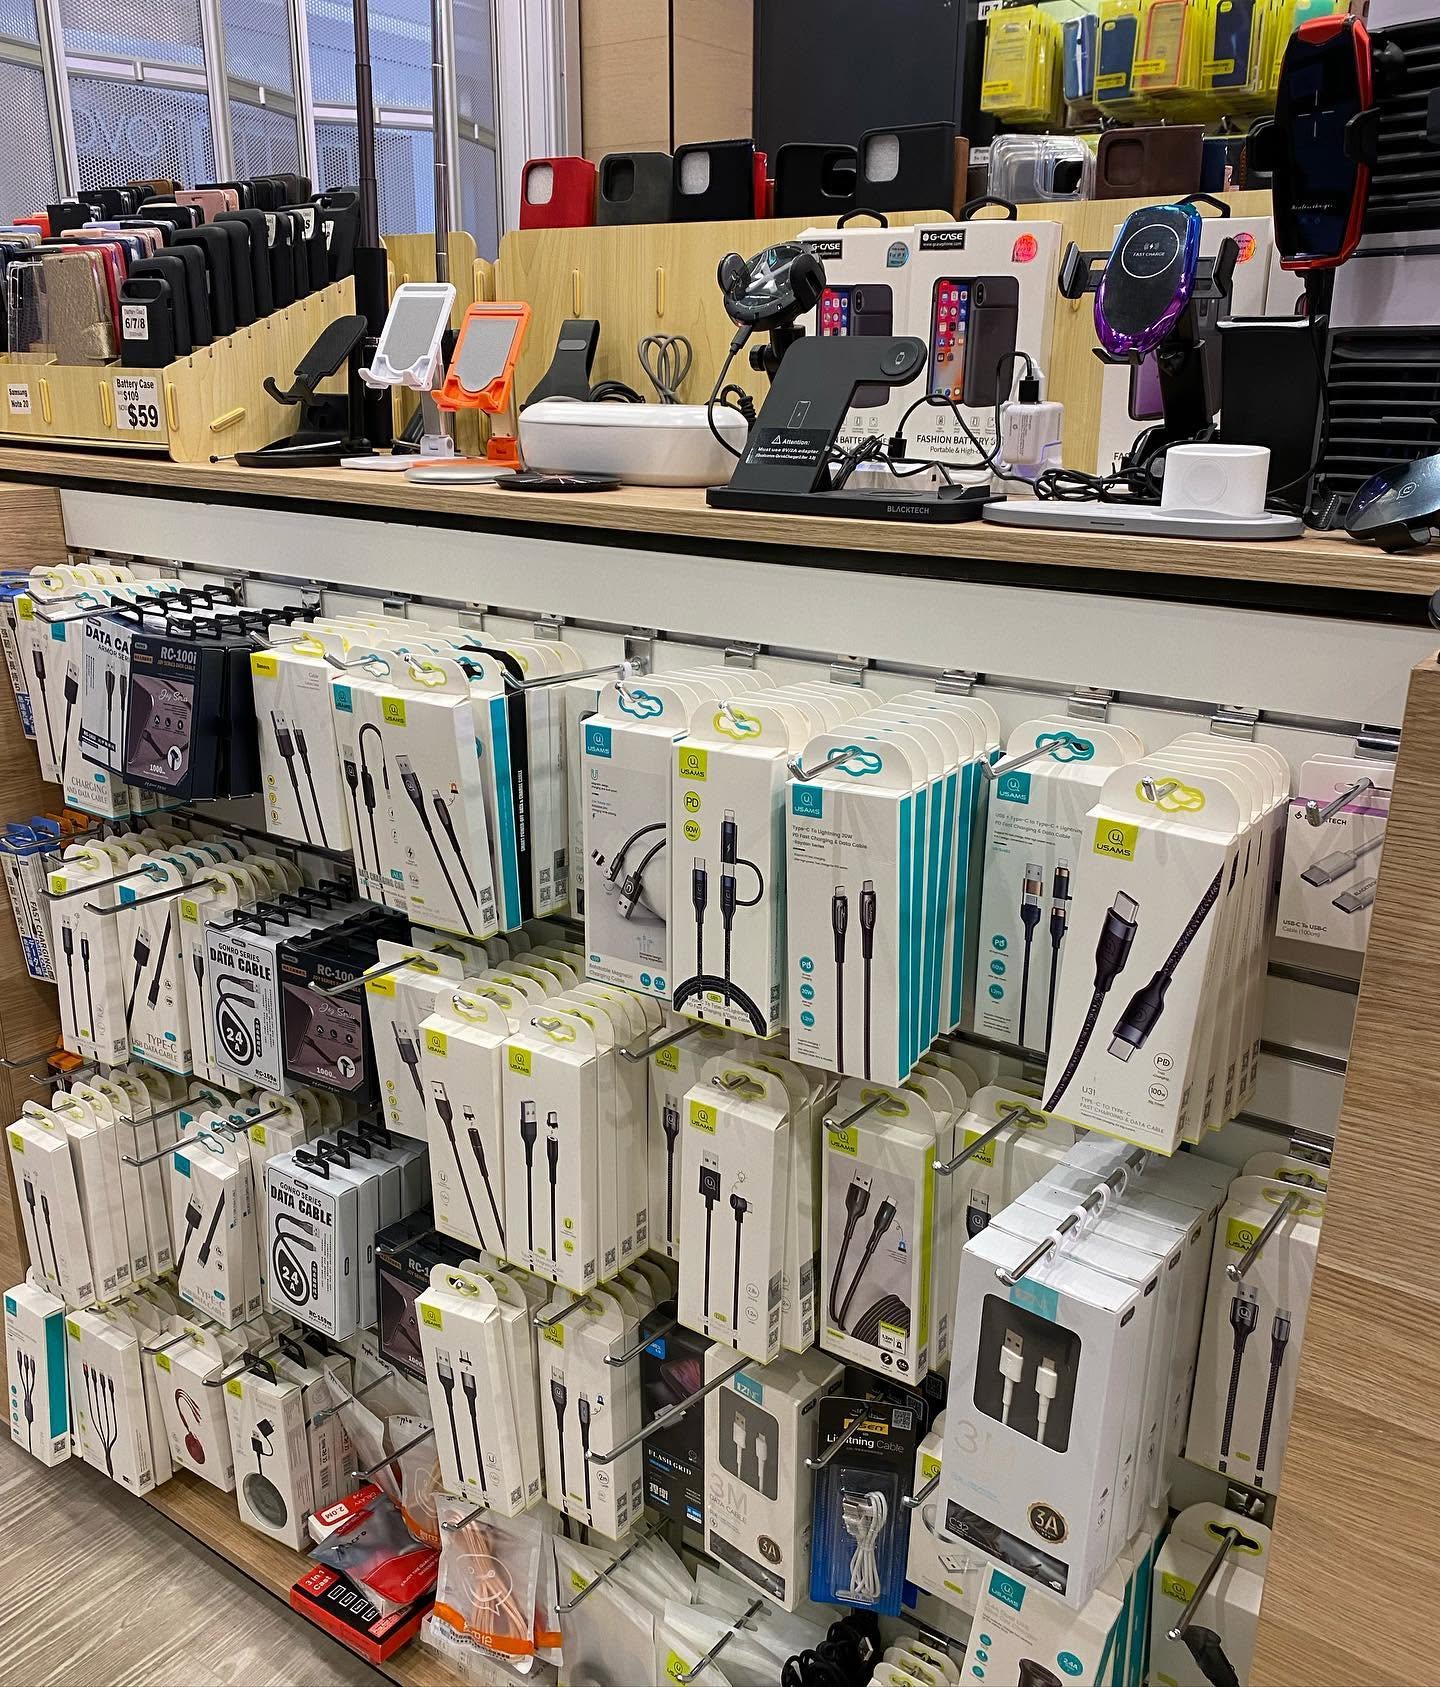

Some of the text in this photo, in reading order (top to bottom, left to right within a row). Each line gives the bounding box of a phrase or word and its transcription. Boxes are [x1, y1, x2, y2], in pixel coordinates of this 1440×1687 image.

[125, 317, 146, 329] 6/7/8
[117, 379, 154, 391] Battery Case
[9, 388, 28, 397] Samsung
[123, 390, 139, 401] $109
[11, 400, 29, 408] Note 20
[128, 403, 158, 429] $59
[782, 438, 810, 446] Attention:
[916, 434, 990, 446] FASHION BATTRY
[887, 505, 930, 515] BLACKTECH
[85, 624, 112, 647] DATA
[98, 644, 117, 656] ARMOR
[161, 646, 197, 665] RC-100i
[385, 716, 405, 724] USAMS
[587, 745, 609, 754] USAMS
[680, 768, 705, 777] USAMS
[66, 786, 77, 795] AND
[71, 776, 108, 795] CHARGING
[999, 790, 1027, 800] USAMS
[686, 797, 699, 808] PD
[794, 806, 820, 815] USAMS
[1010, 815, 1029, 823] Type-C
[1036, 820, 1055, 828] Type-C
[793, 825, 810, 833] Type-C
[818, 829, 841, 839] Lightning
[1013, 823, 1037, 834] Charging
[811, 835, 834, 845] Charging
[1096, 843, 1131, 856] USAMS
[30, 901, 53, 973] FAST CHARGING
[1298, 928, 1321, 937] (100cm)
[218, 942, 260, 962] GONRO SERIES
[210, 947, 272, 982] DATA CABLE
[589, 970, 625, 983] Charging Cable
[703, 1006, 721, 1017] Charging
[146, 1033, 177, 1054] TYPE-C
[144, 1043, 157, 1055] DATA
[157, 1049, 178, 1062] CABLE
[427, 1045, 446, 1056] USAMS
[656, 1059, 677, 1070] USAMS
[1156, 1056, 1170, 1067] PD
[509, 1063, 529, 1074] USAMS
[1081, 1096, 1102, 1107] TYPE-C
[1111, 1105, 1132, 1117] TYPE-C
[1080, 1102, 1093, 1110] FAST
[1094, 1107, 1124, 1121] CHARGING
[1130, 1119, 1146, 1127] DATA
[1146, 1123, 1165, 1133] CABLE
[691, 1119, 714, 1132] USAMS
[830, 1140, 855, 1153] USAMS
[279, 1182, 322, 1207] GONRO SERIES
[271, 1185, 332, 1227] DATA CABLE
[408, 1258, 430, 1277] RC-1
[827, 1433, 905, 1454] Litning Cable
[648, 1449, 692, 1476] FLASH GRID
[325, 1506, 345, 1520] 2.0M
[725, 1504, 747, 1524] CABLE
[1034, 1508, 1059, 1536] 3A
[761, 1537, 777, 1558] 3A
[312, 1574, 319, 1582] in
[313, 1576, 332, 1591] Cast
[990, 1587, 1019, 1607] USAMS
